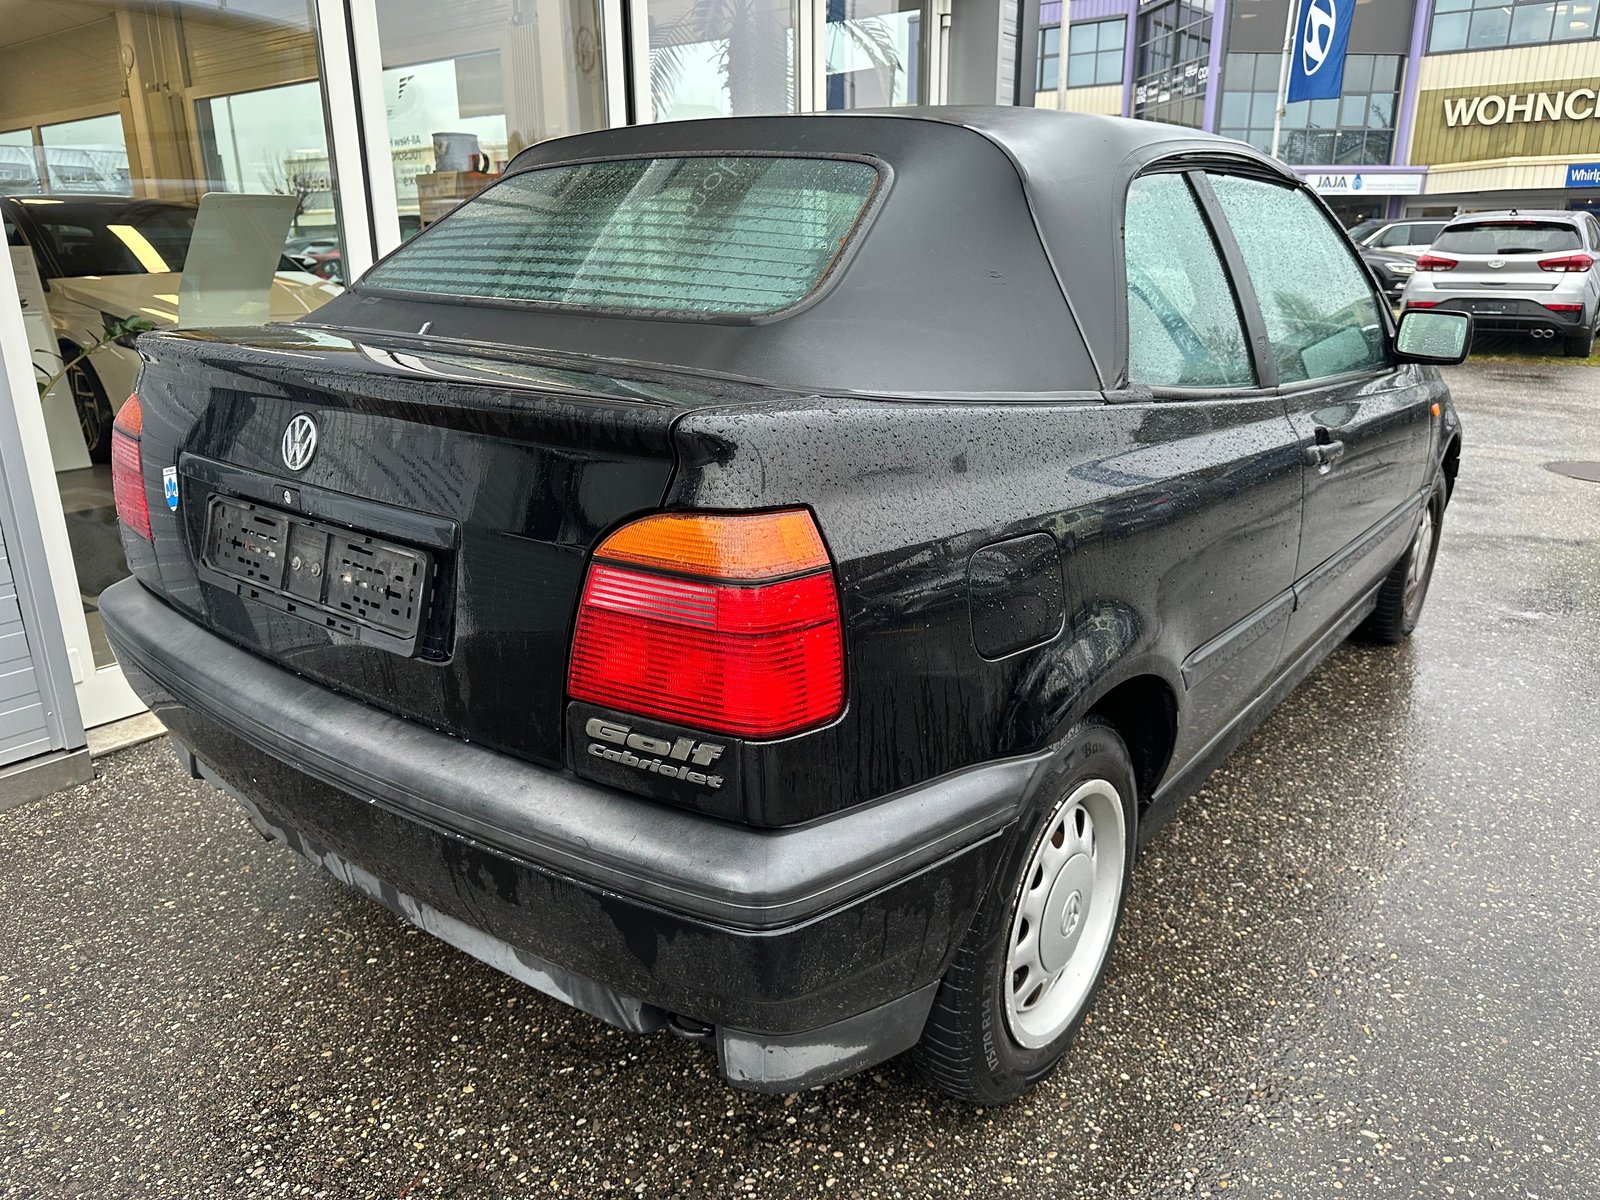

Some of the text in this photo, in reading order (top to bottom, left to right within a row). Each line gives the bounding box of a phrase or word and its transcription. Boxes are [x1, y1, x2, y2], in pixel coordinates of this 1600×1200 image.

[1444, 88, 1600, 127] WOHNC
[1316, 176, 1347, 188] JAJA
[585, 717, 727, 766] Golf
[587, 742, 726, 789] Cabriolet
[981, 997, 992, 1030] R14
[982, 1030, 999, 1072] 175/70
